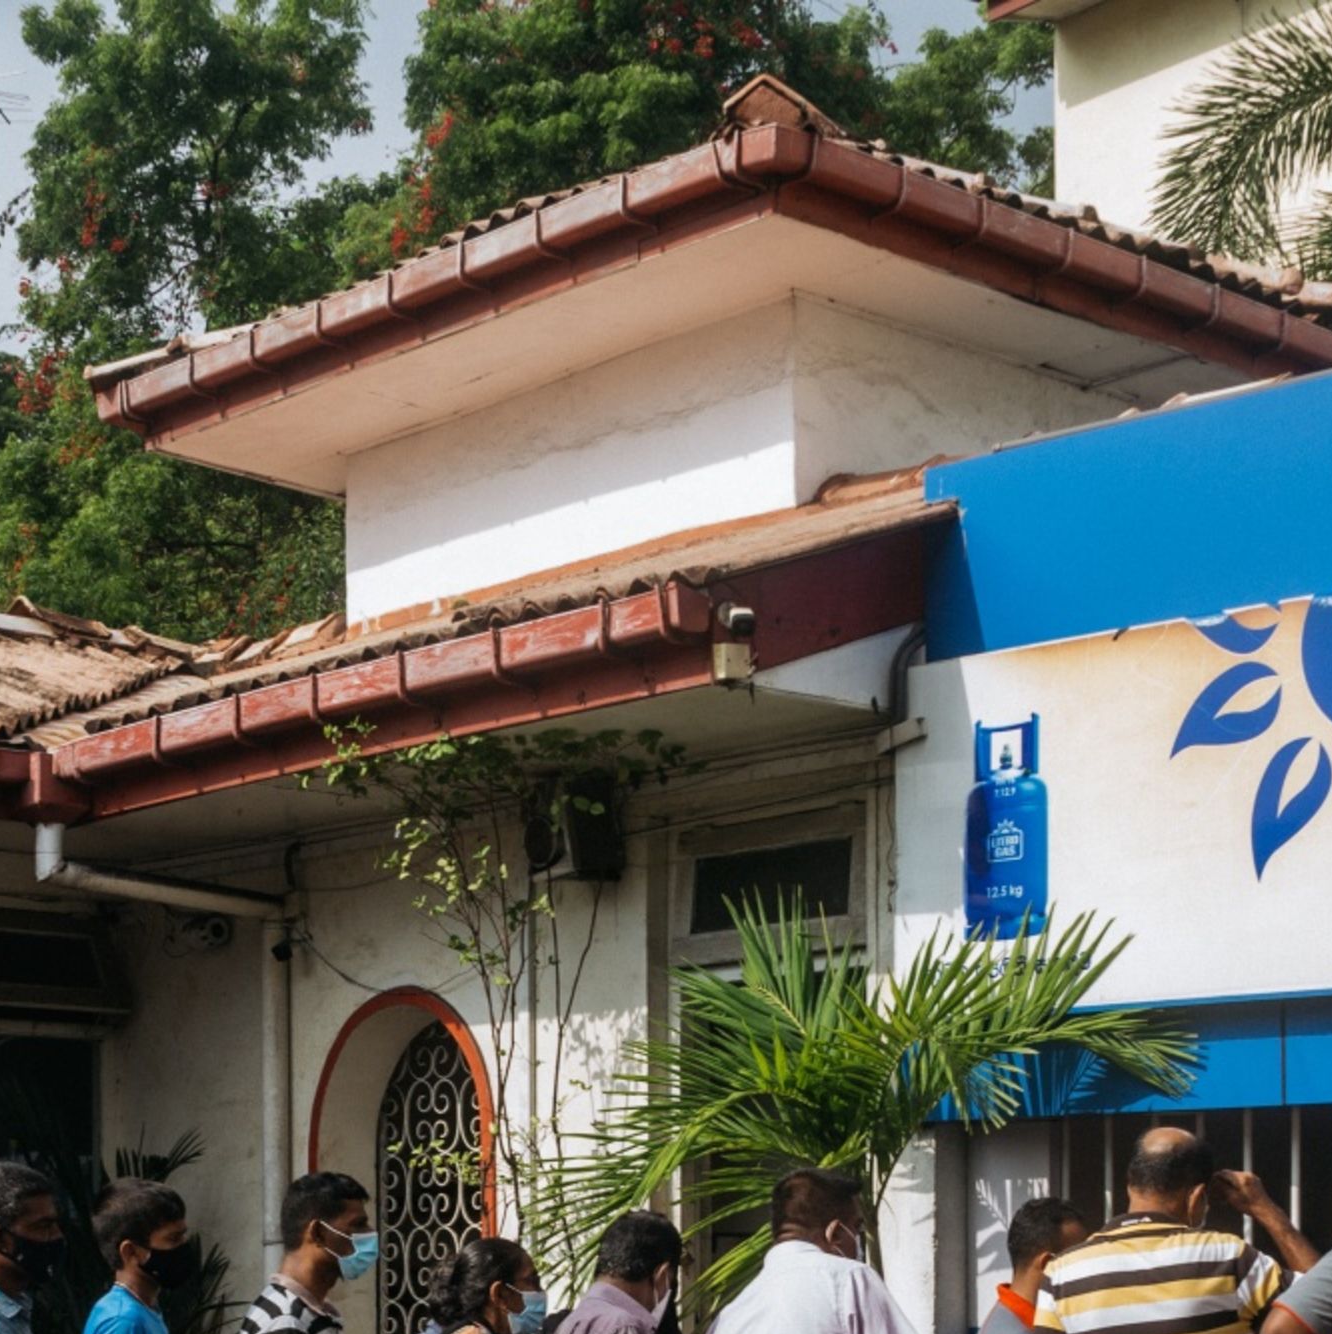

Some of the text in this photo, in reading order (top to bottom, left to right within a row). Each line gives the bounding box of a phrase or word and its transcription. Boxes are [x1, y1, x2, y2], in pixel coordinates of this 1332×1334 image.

[994, 846, 1016, 858] GAS
[987, 884, 1024, 899] 12.5 kg
